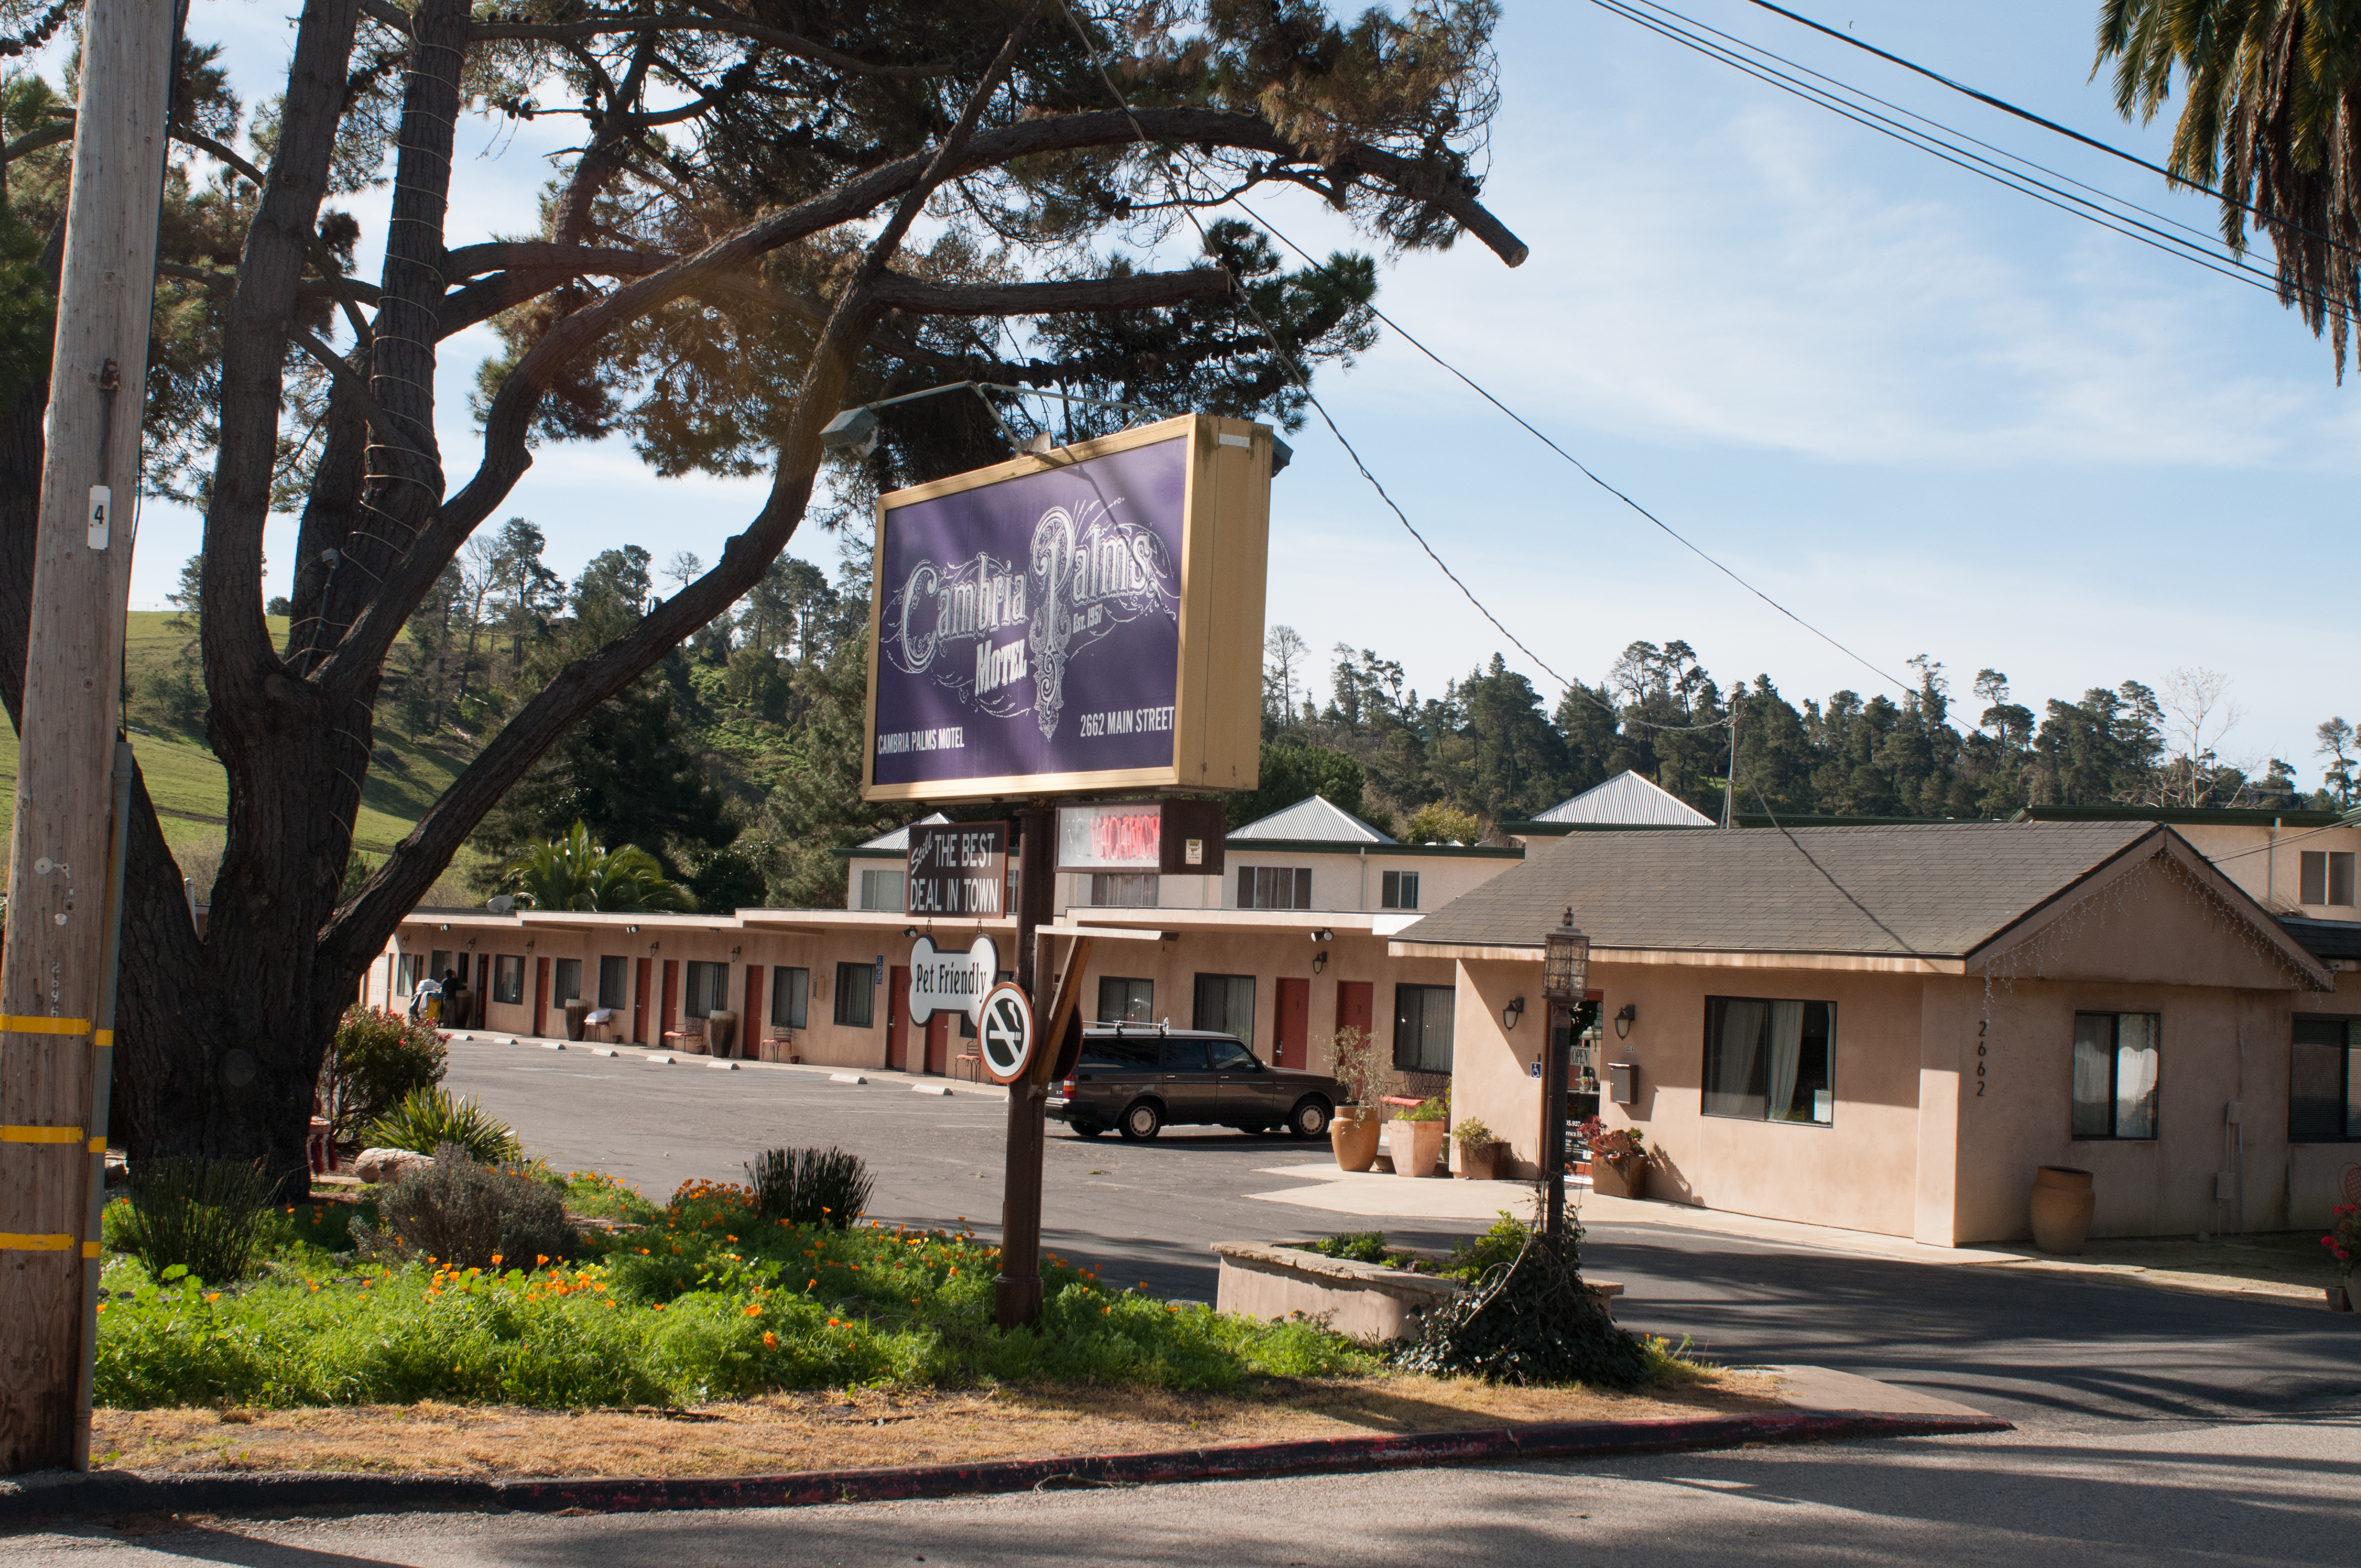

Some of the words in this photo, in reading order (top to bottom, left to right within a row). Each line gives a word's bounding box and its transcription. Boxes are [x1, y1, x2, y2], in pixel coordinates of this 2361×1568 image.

[94, 505, 105, 525] 4
[901, 552, 1028, 673] Cambria
[1087, 603, 1103, 628] 1957
[1080, 712, 1105, 737] 2662
[1107, 710, 1133, 734] MAIN
[1135, 706, 1174, 733] STREET
[878, 732, 910, 755] CAMBRIA
[912, 729, 937, 752] PALMS
[938, 727, 965, 749] MOTEL
[911, 830, 933, 875] Still
[935, 834, 958, 867] THE
[961, 833, 995, 868] BEST
[910, 879, 942, 911] DEAL
[947, 879, 959, 911] IN
[964, 878, 998, 912] TOWN
[916, 963, 934, 993] Pet
[939, 962, 987, 1004] Friendly
[1572, 1048, 1588, 1064] OPEN
[1977, 1021, 1988, 1097] 2662
